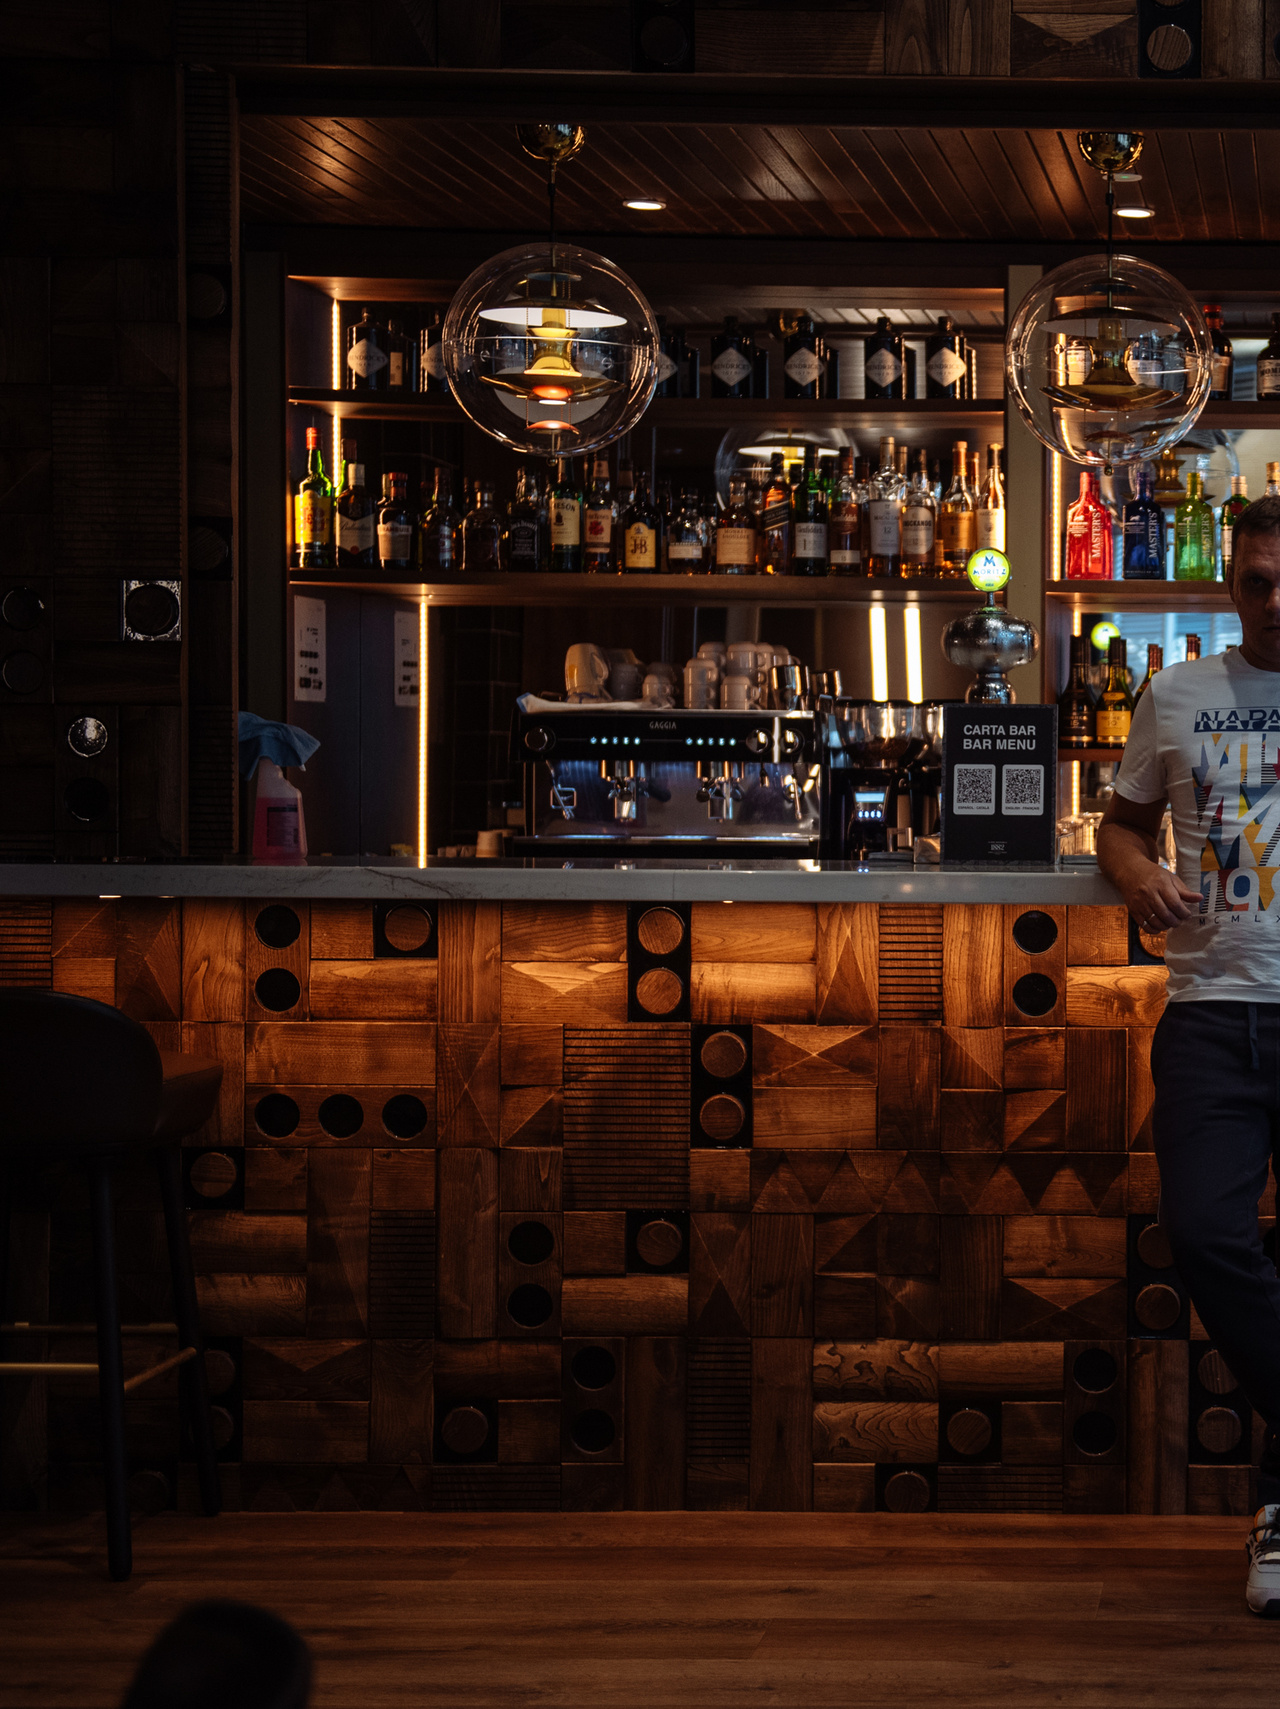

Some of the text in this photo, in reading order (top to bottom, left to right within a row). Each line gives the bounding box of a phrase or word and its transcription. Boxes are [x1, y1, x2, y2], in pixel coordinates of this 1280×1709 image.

[1091, 511, 1102, 559] MASTER'S
[1148, 511, 1158, 559] MASTER'S
[1201, 512, 1211, 559] MASTER'S
[649, 720, 677, 730] GAGGIA
[963, 724, 1036, 736] CARTA BAR
[963, 738, 1036, 750] BAR MENU
